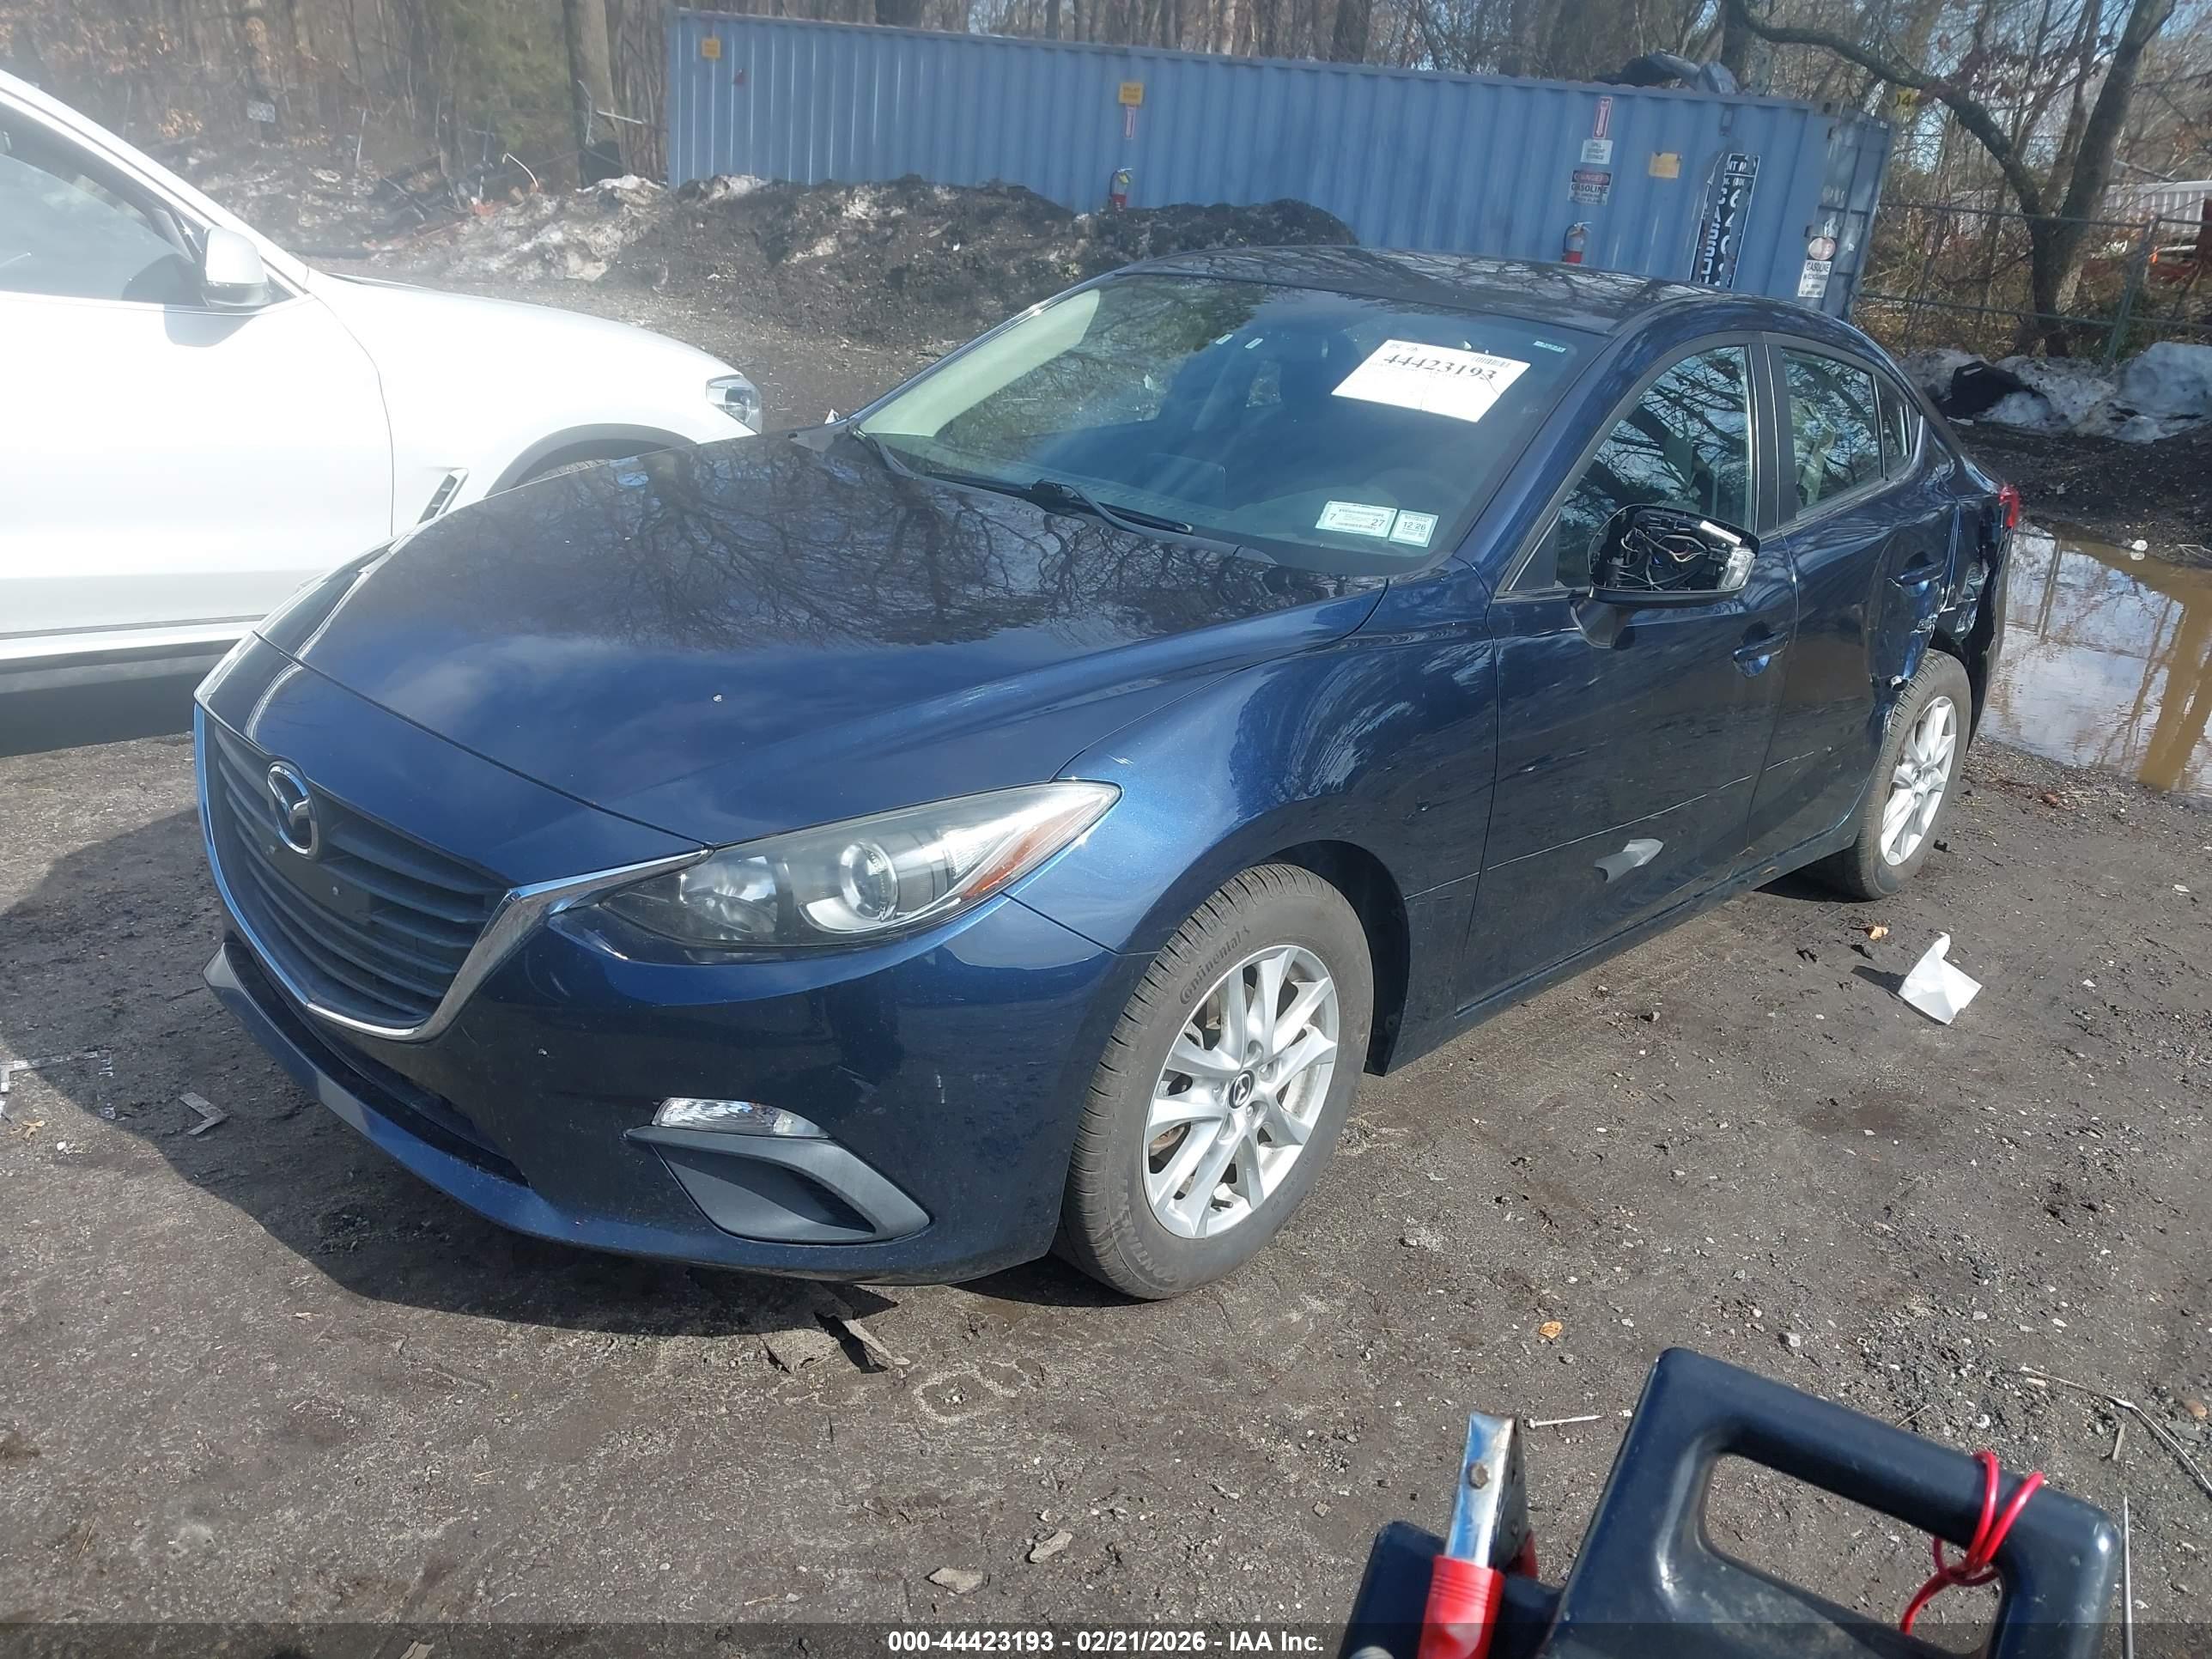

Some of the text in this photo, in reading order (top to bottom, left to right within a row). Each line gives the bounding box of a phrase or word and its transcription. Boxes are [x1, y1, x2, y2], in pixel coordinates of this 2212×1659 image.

[1571, 183, 1608, 194] GASOLINE
[1383, 354, 1498, 380] 44423193
[1180, 931, 1242, 1005] Continental
